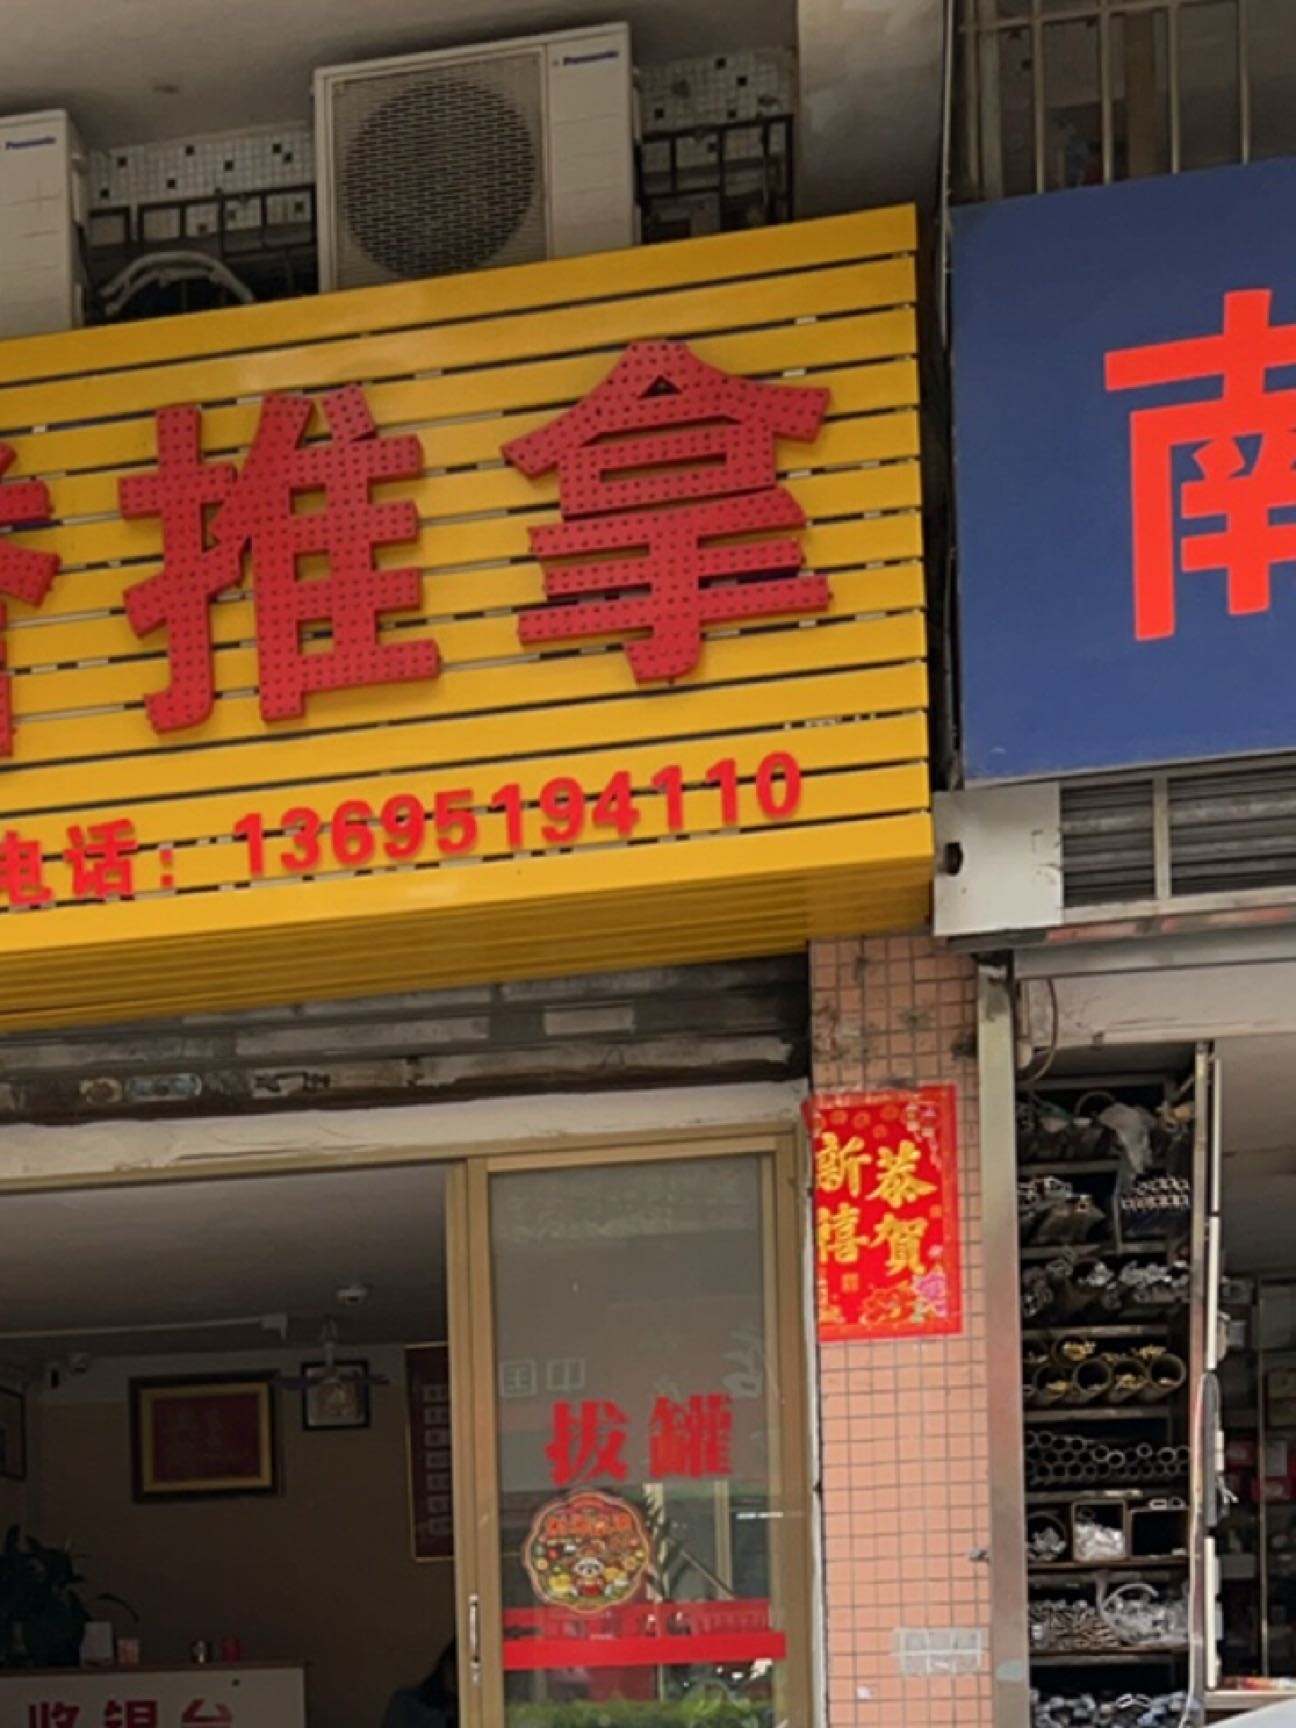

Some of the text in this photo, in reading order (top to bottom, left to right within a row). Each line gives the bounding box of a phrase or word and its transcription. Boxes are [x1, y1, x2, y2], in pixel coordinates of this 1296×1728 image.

[1105, 288, 1296, 642] 南
[233, 752, 802, 875] 13695194110
[545, 1394, 734, 1486] 拔罐
